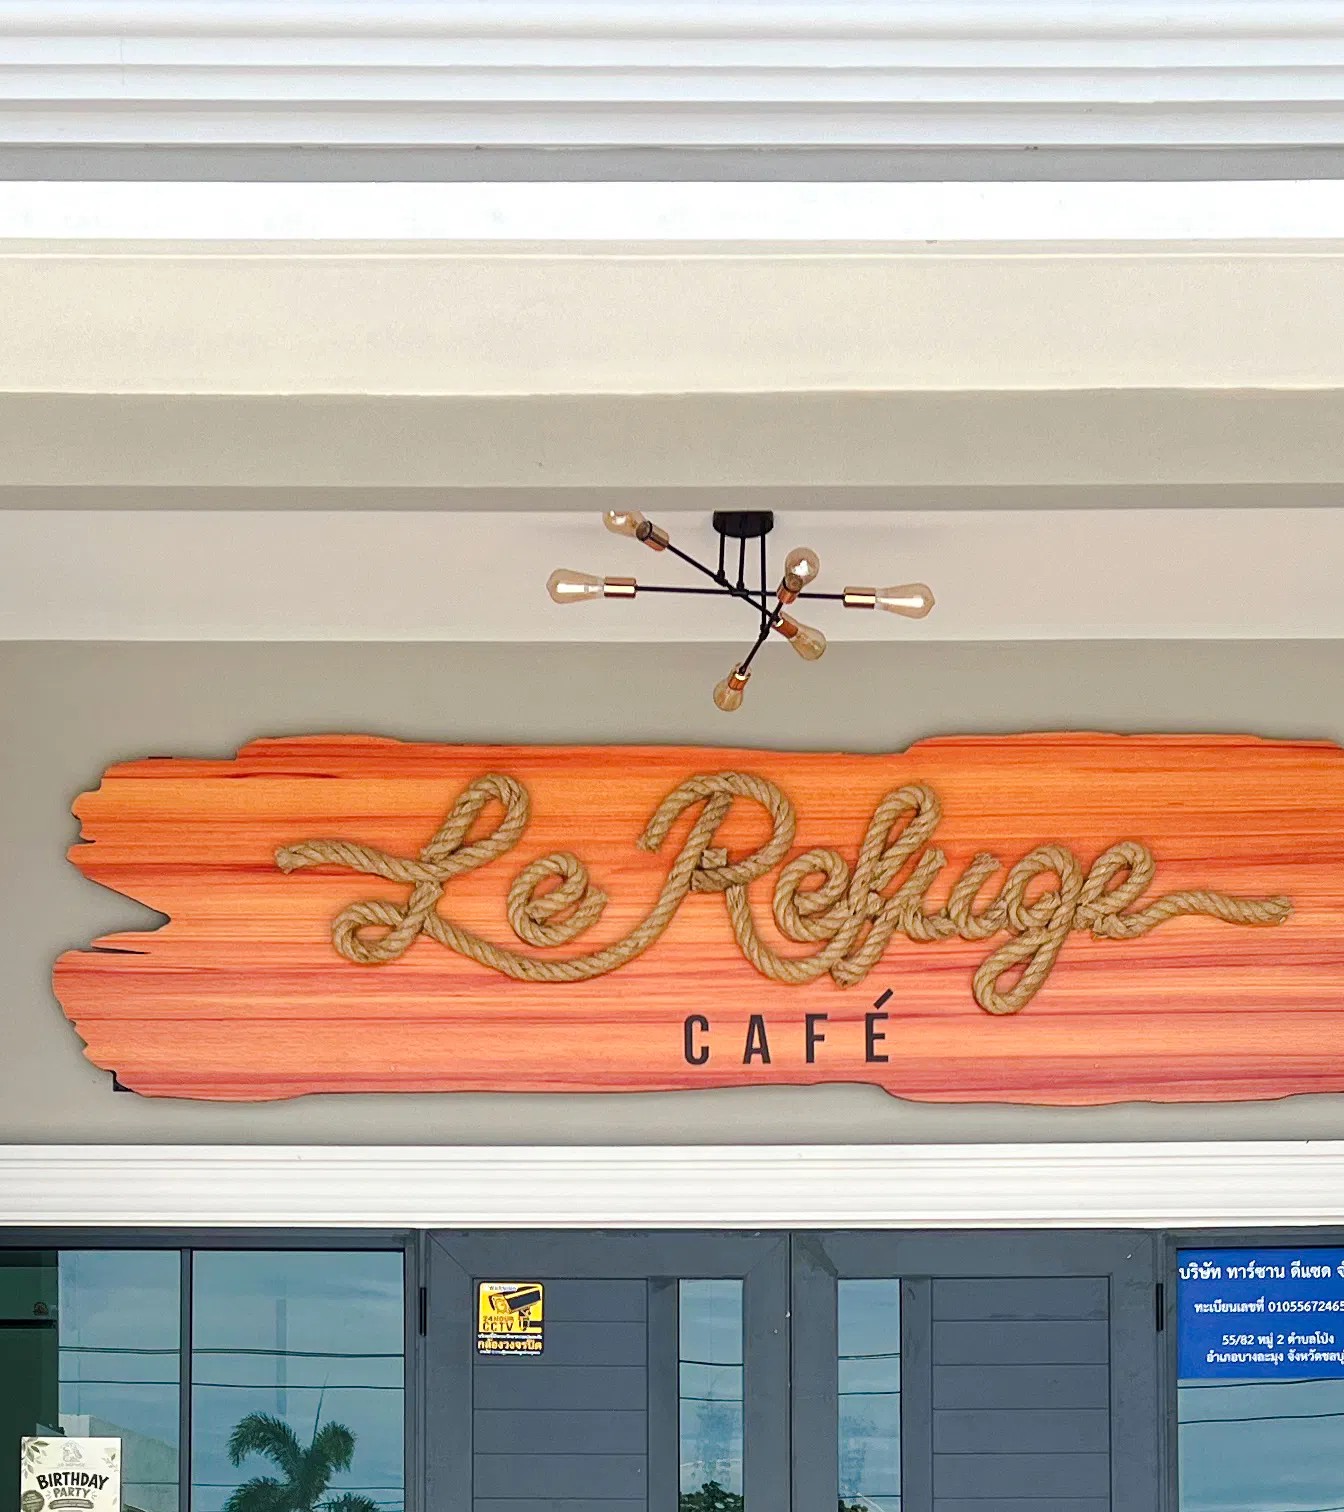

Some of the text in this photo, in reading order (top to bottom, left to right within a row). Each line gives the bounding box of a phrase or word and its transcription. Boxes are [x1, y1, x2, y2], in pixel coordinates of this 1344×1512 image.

[275, 771, 1294, 1016] Le Refuge
[683, 988, 894, 1065] CAFÉ
[1178, 1260, 1222, 1280] บริษัท
[1226, 1260, 1286, 1279] ทาร์ซาน
[1194, 1296, 1265, 1313] ทะเบียนเลขที่
[482, 1322, 514, 1331] CCTV
[1221, 1331, 1335, 1349] 55/82 หมู่ 2 ตำบลโป่ง
[36, 1471, 110, 1491] BIRTHDAY
[53, 1487, 91, 1499] PARTY
